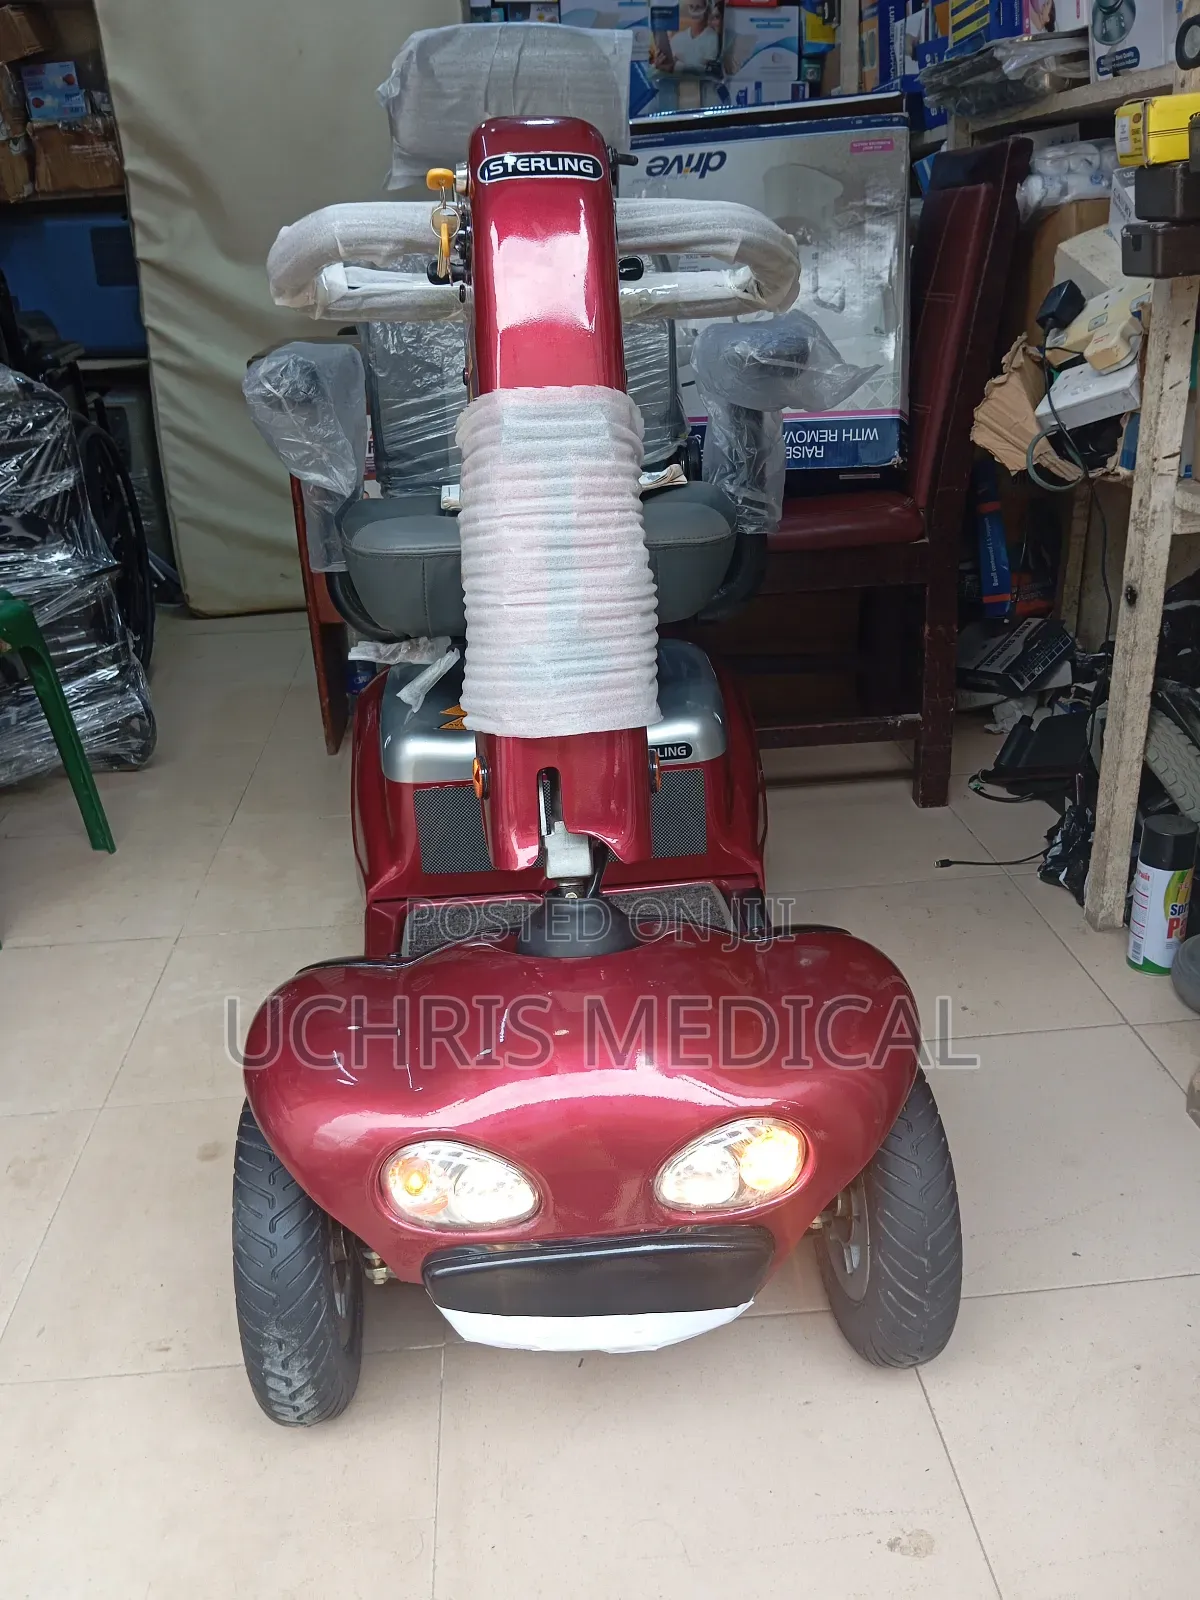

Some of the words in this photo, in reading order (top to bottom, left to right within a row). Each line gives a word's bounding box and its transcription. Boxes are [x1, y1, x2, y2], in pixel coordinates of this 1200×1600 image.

[487, 154, 594, 175] STERLING
[645, 150, 727, 179] drive
[842, 428, 879, 442] WITH
